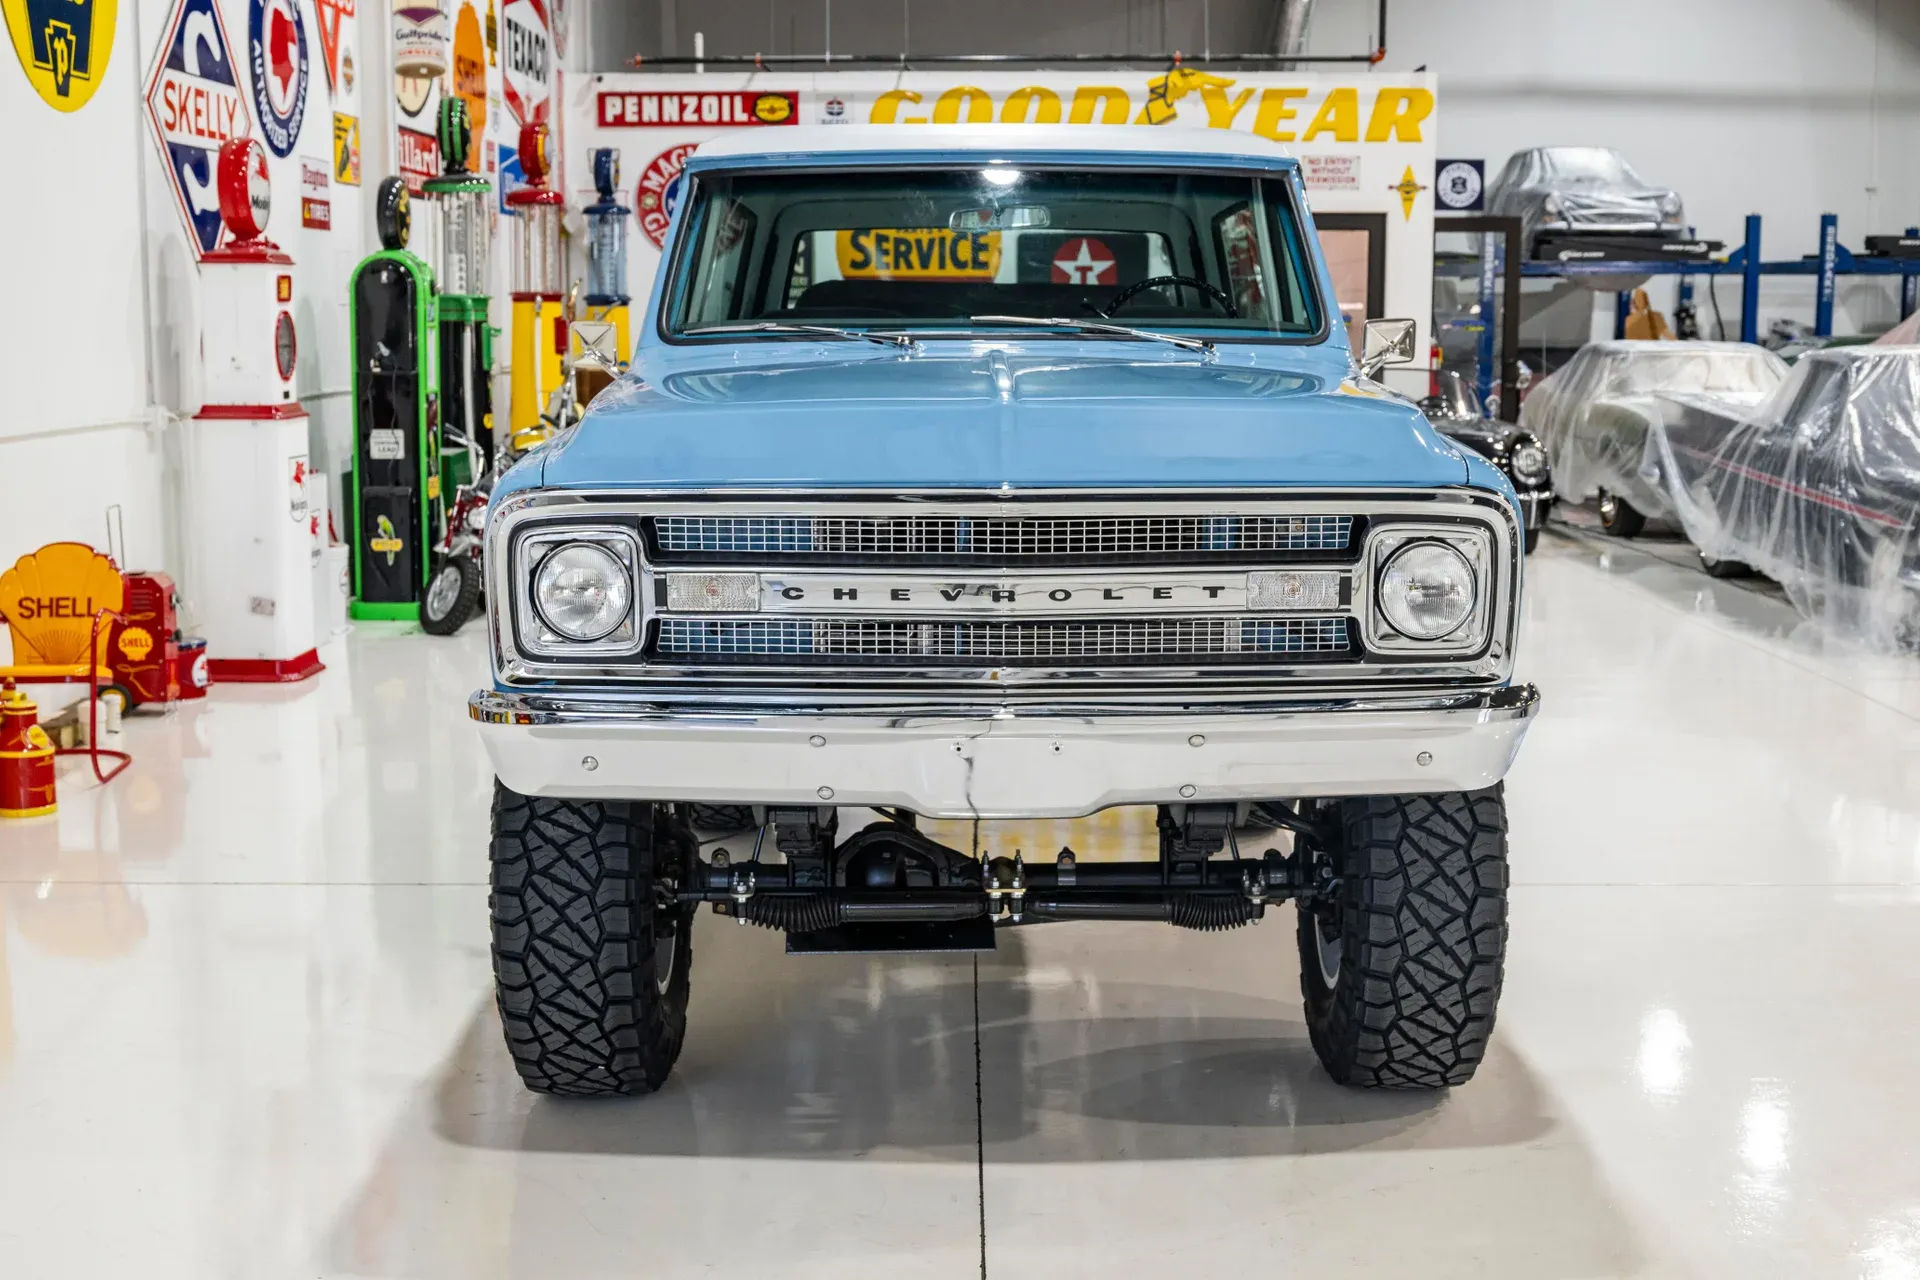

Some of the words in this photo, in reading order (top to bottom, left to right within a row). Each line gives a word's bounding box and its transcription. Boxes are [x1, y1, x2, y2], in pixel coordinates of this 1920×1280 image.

[163, 79, 237, 140] SKELLY
[604, 95, 749, 123] PENNZOIL
[1325, 158, 1353, 166] ENTRY
[1312, 167, 1351, 175] WITHOUT
[1306, 176, 1356, 184] PERMISSION
[849, 229, 990, 271] SERVICE
[780, 585, 1226, 602] CHEVROLET
[18, 597, 96, 619] SHELL
[122, 638, 150, 648] SHELL
